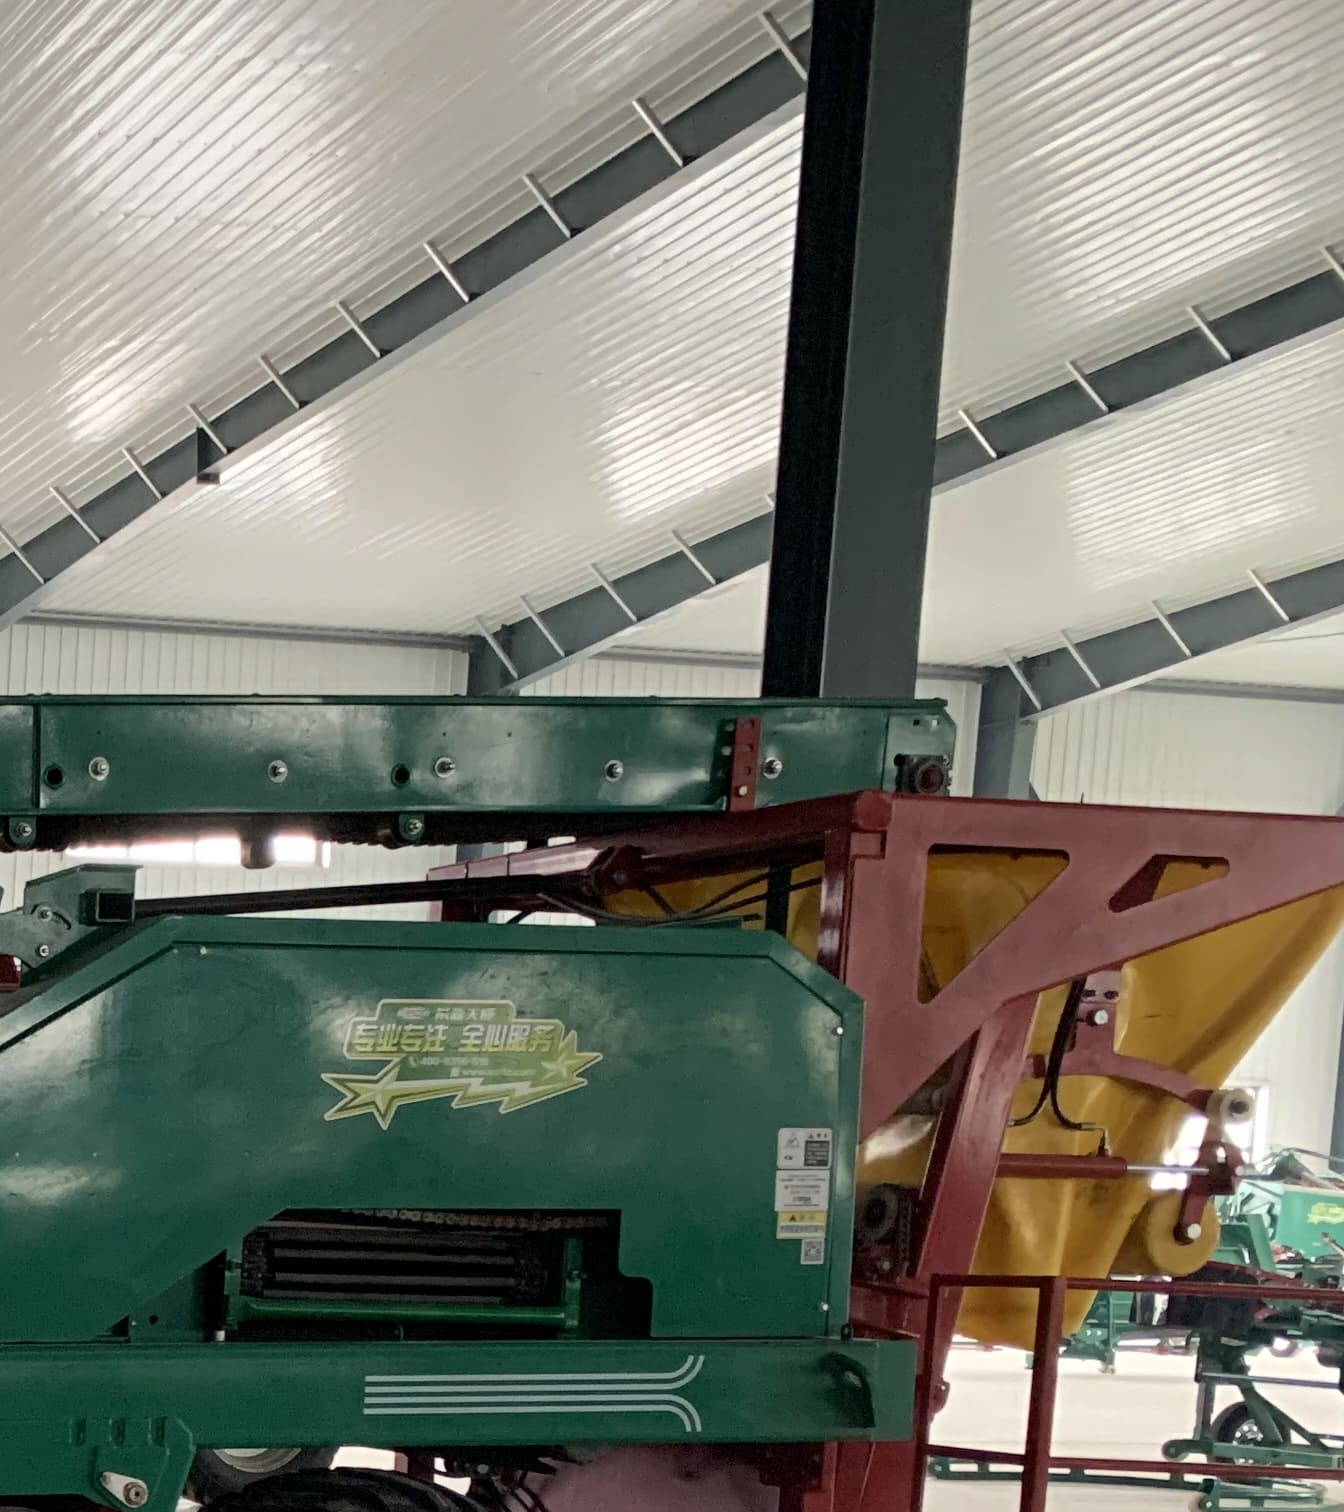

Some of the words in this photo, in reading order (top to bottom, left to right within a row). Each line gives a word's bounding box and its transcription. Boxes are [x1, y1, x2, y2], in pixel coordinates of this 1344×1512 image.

[353, 1023, 449, 1052] 专业专注
[458, 1023, 555, 1052] 全心服务
